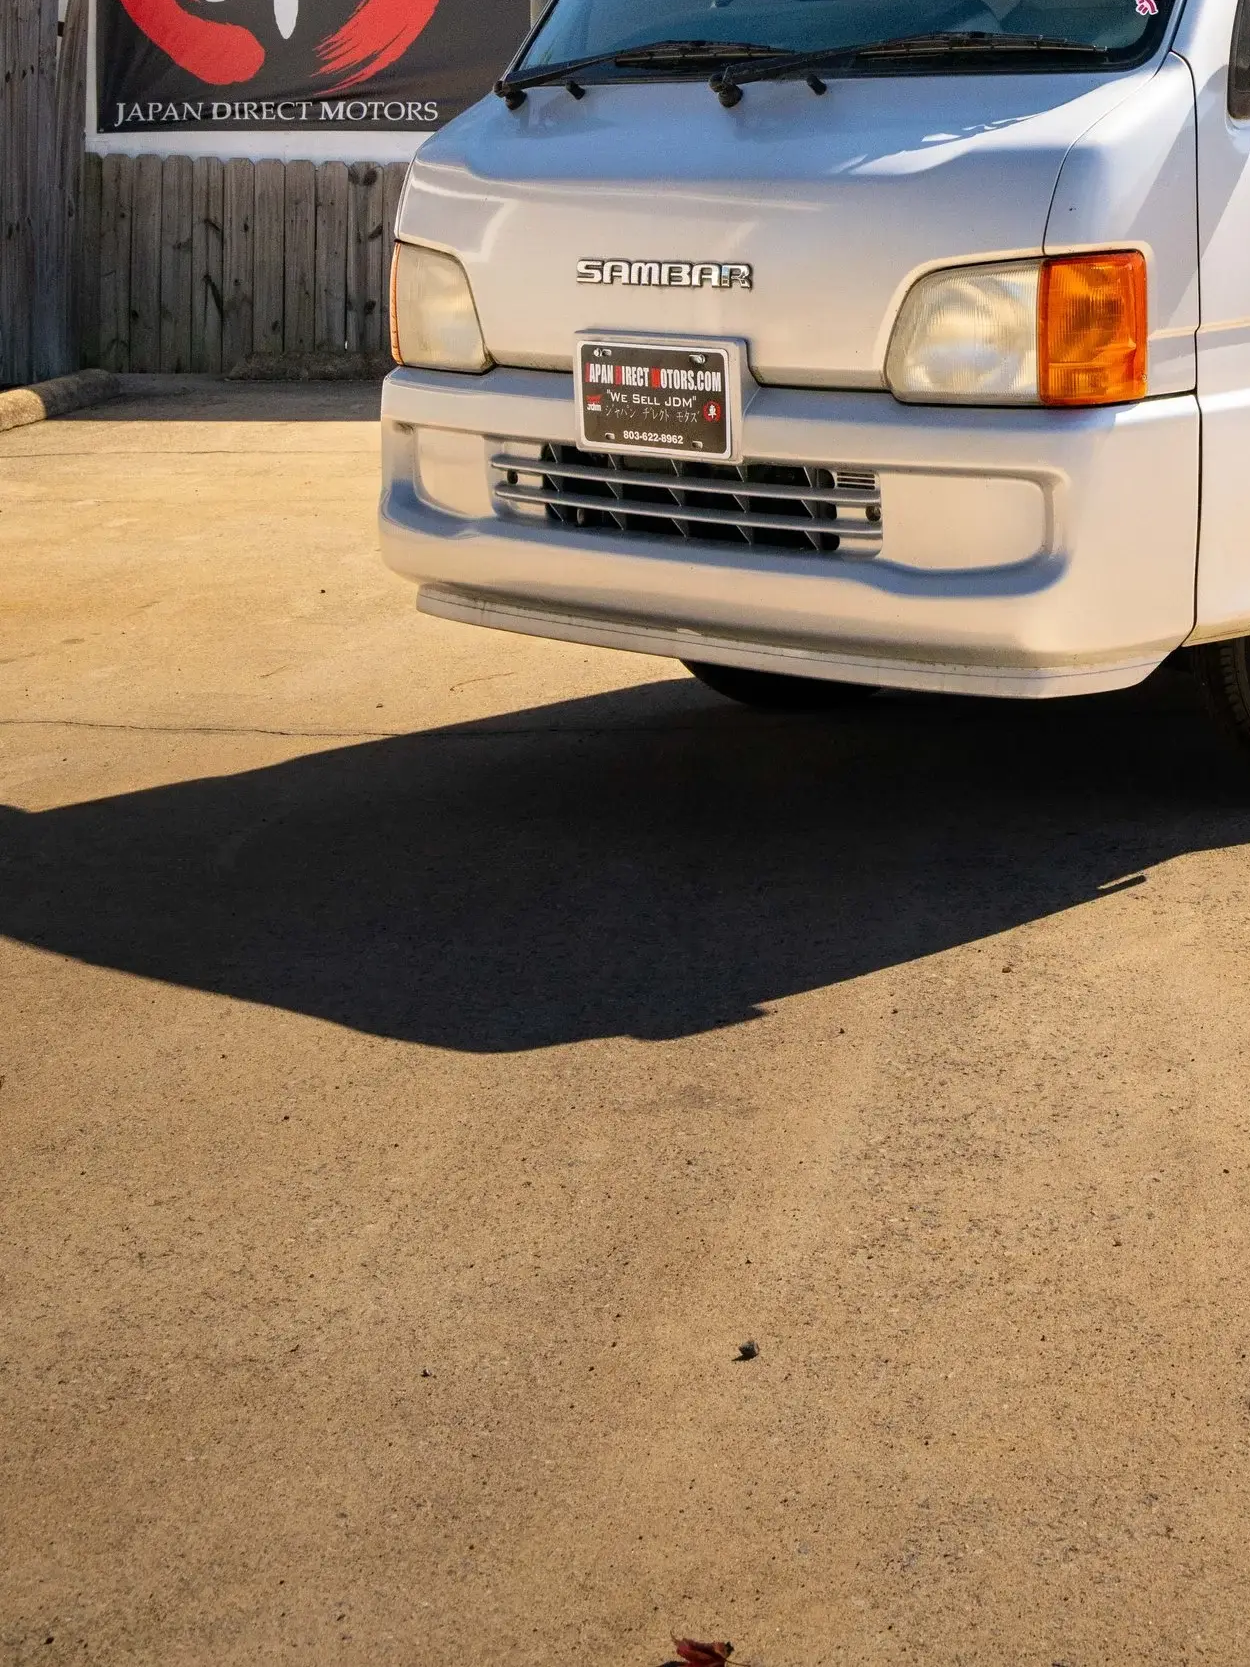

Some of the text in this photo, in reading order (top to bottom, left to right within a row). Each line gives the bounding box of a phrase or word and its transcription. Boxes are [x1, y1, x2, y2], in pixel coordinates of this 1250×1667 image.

[114, 101, 438, 127] JAPAN DIRECT MOTORS
[576, 259, 753, 289] SAMBAR
[623, 430, 684, 444] 803-622-8962
